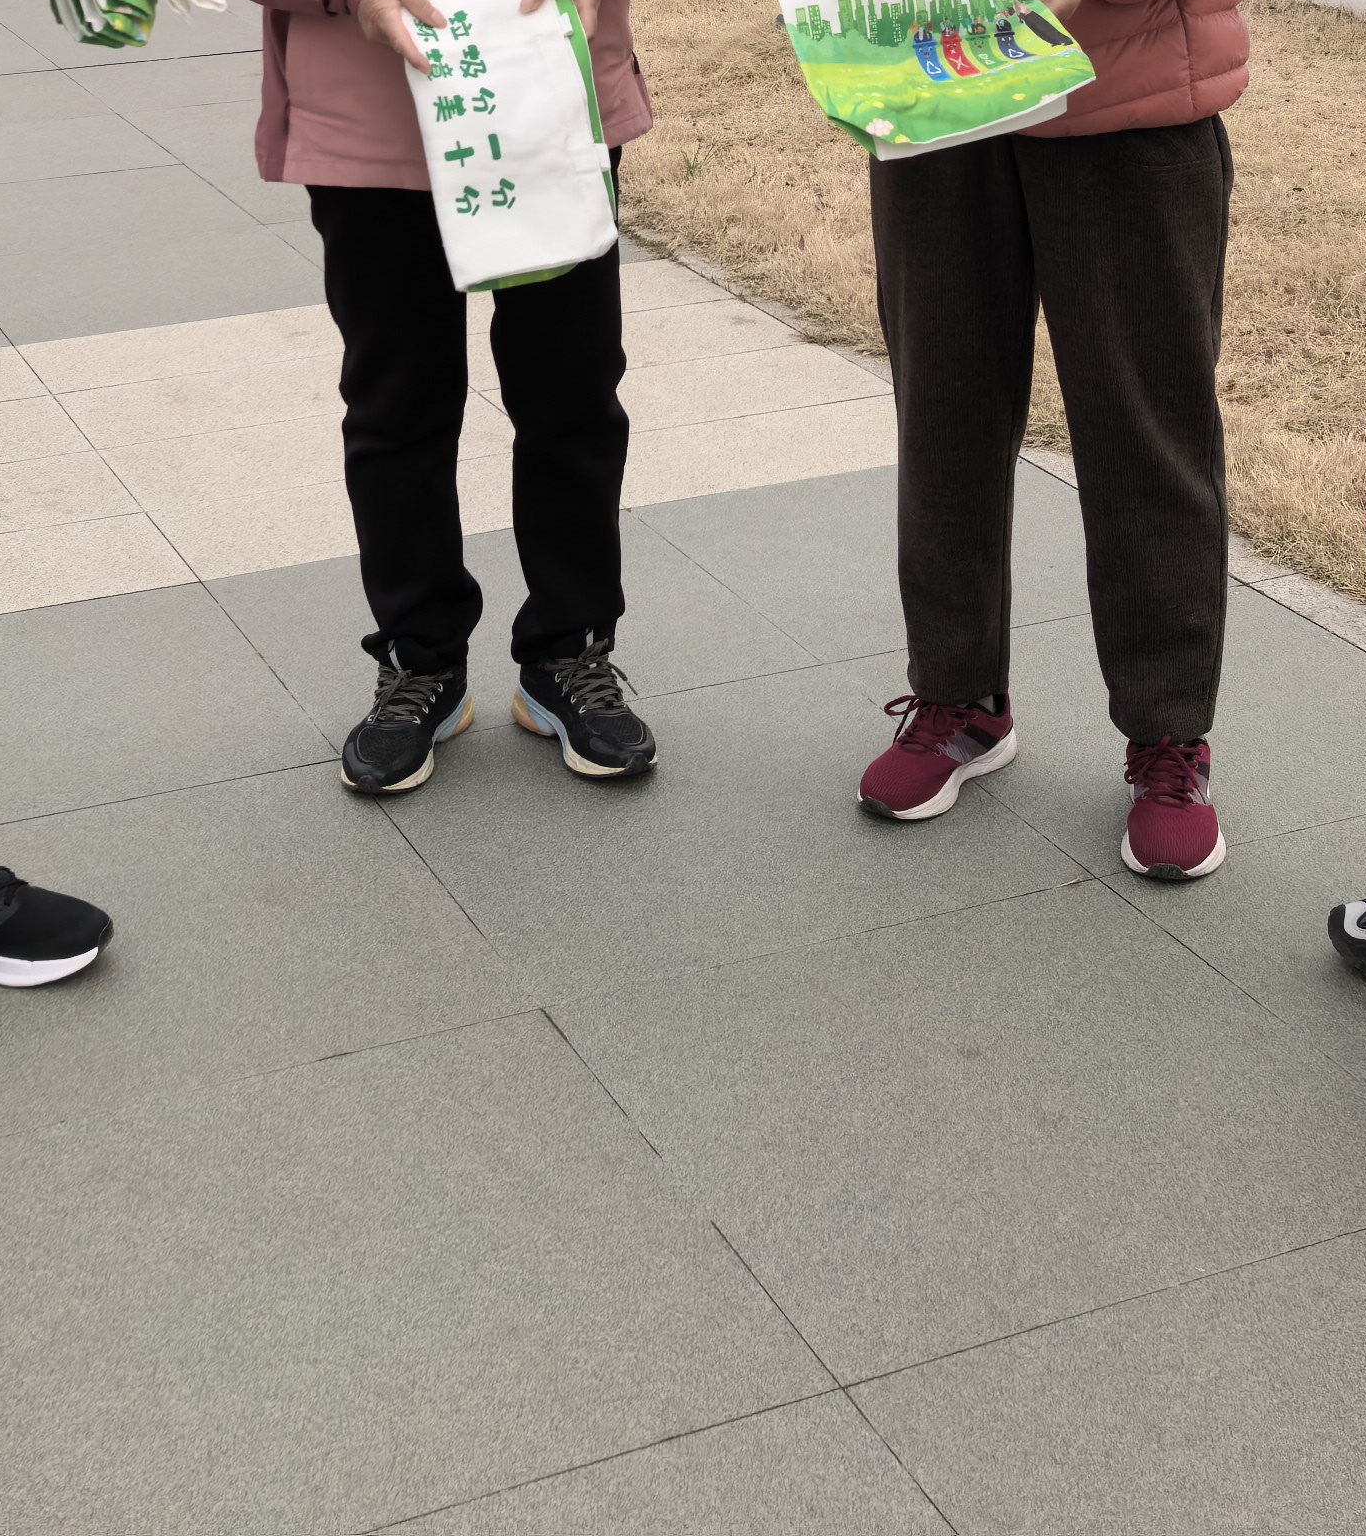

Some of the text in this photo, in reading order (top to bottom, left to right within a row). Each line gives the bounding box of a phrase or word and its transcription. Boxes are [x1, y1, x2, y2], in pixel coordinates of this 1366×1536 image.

[448, 10, 516, 210] 垃圾分一分
